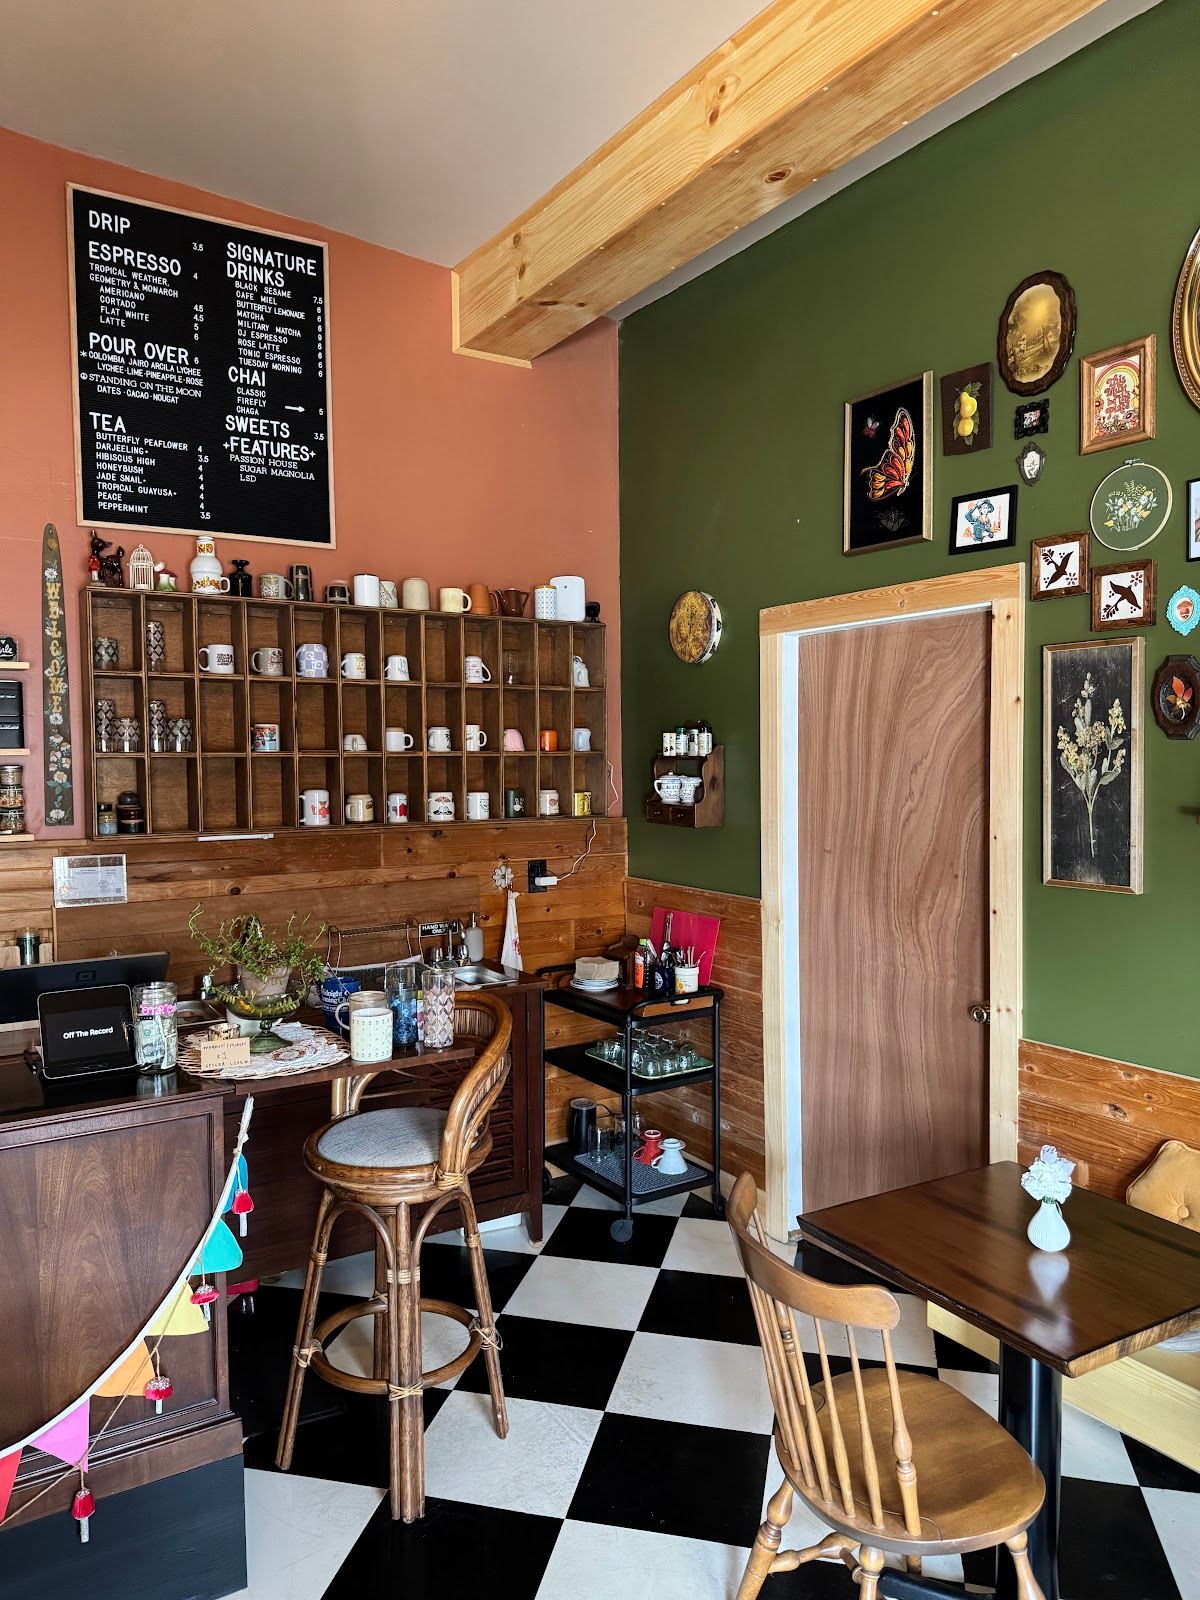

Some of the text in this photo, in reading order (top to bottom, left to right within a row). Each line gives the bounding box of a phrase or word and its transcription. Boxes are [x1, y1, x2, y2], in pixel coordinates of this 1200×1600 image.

[89, 210, 130, 234] DRIP
[89, 241, 181, 276] ESPRESSO
[227, 242, 316, 276] SIGNATURE
[89, 263, 170, 287] TROPICAL WEATHER,
[227, 261, 284, 287] DRINKS
[90, 273, 178, 298] GEOMETRY & MONARCH
[100, 285, 145, 301] AMERICANO
[235, 281, 323, 304] BLACK SESAME 7.5
[100, 295, 136, 309] CORTADO
[236, 291, 254, 301] CAFE
[261, 296, 277, 305] MIEL
[101, 306, 199, 331] FLAT WHITE 5
[237, 300, 272, 314] BUTTERFLY
[274, 306, 305, 319] LEMONADE
[237, 310, 264, 321] MATCHA
[100, 316, 199, 341] LATTE 6
[238, 319, 269, 331] MILITARY
[276, 326, 301, 337] MATCHA
[238, 338, 255, 348] ROSE
[259, 341, 280, 352] LATTE
[251, 331, 288, 344] ESPRESSO
[89, 332, 199, 365] POUR OVER 6
[238, 348, 260, 358] TONIC
[265, 352, 300, 364] ESPRESSO
[89, 351, 201, 376] COLOMBIA JAIRO ARCILA LYCHEE
[239, 357, 268, 369] TUESDAY
[272, 363, 302, 374] MORNING
[89, 374, 202, 397] STANDING ON THE MOON
[228, 366, 266, 387] CHAI
[237, 387, 266, 397] CLASSIC
[236, 406, 259, 415] CHAGA
[237, 397, 323, 416] FIREFLY 5
[89, 412, 126, 433] TEA
[225, 415, 290, 438] SWEETS
[96, 433, 140, 445] BUTTERFLY
[145, 438, 188, 451] PEAFLOWER
[96, 452, 133, 462] HIBISCUS
[137, 457, 155, 466] HIGH
[198, 455, 209, 463] 3.5
[230, 454, 298, 469] PASSION HOUSE
[96, 462, 203, 482] HONEYBUSH 4
[96, 472, 116, 481] JADE
[240, 465, 315, 480] SUGAR MAGNOLIA
[240, 474, 256, 482] LSD
[97, 482, 133, 493] TROPICAL
[98, 492, 122, 501] PEACE
[98, 502, 148, 513] PEPPERMINT
[46, 582, 63, 713] WELCOME
[63, 1031, 74, 1039] Off
[90, 1026, 113, 1036] Record
